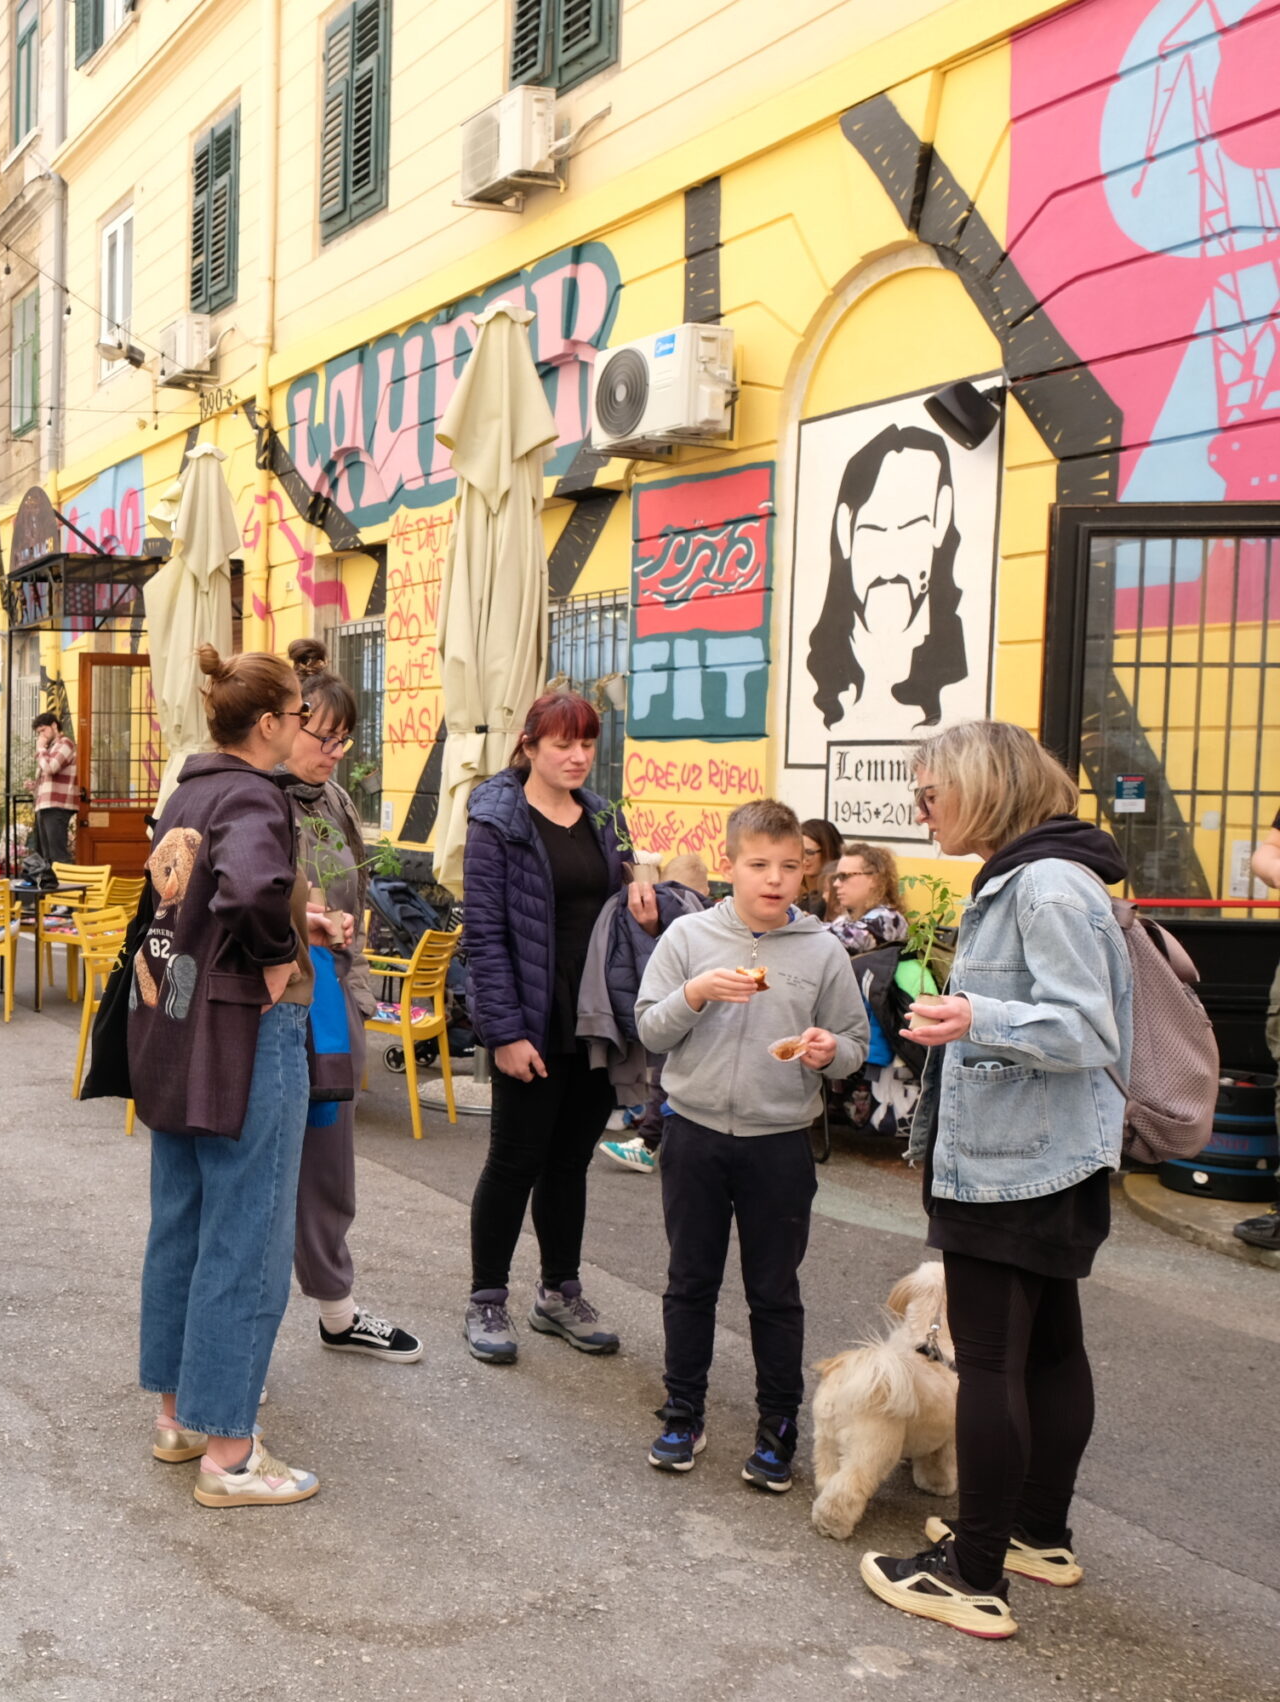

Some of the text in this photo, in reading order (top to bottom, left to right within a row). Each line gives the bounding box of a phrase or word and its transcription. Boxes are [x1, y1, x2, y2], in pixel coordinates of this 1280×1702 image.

[289, 254, 610, 516] LAUR
[632, 636, 765, 721] FIT
[149, 937, 171, 959] 82
